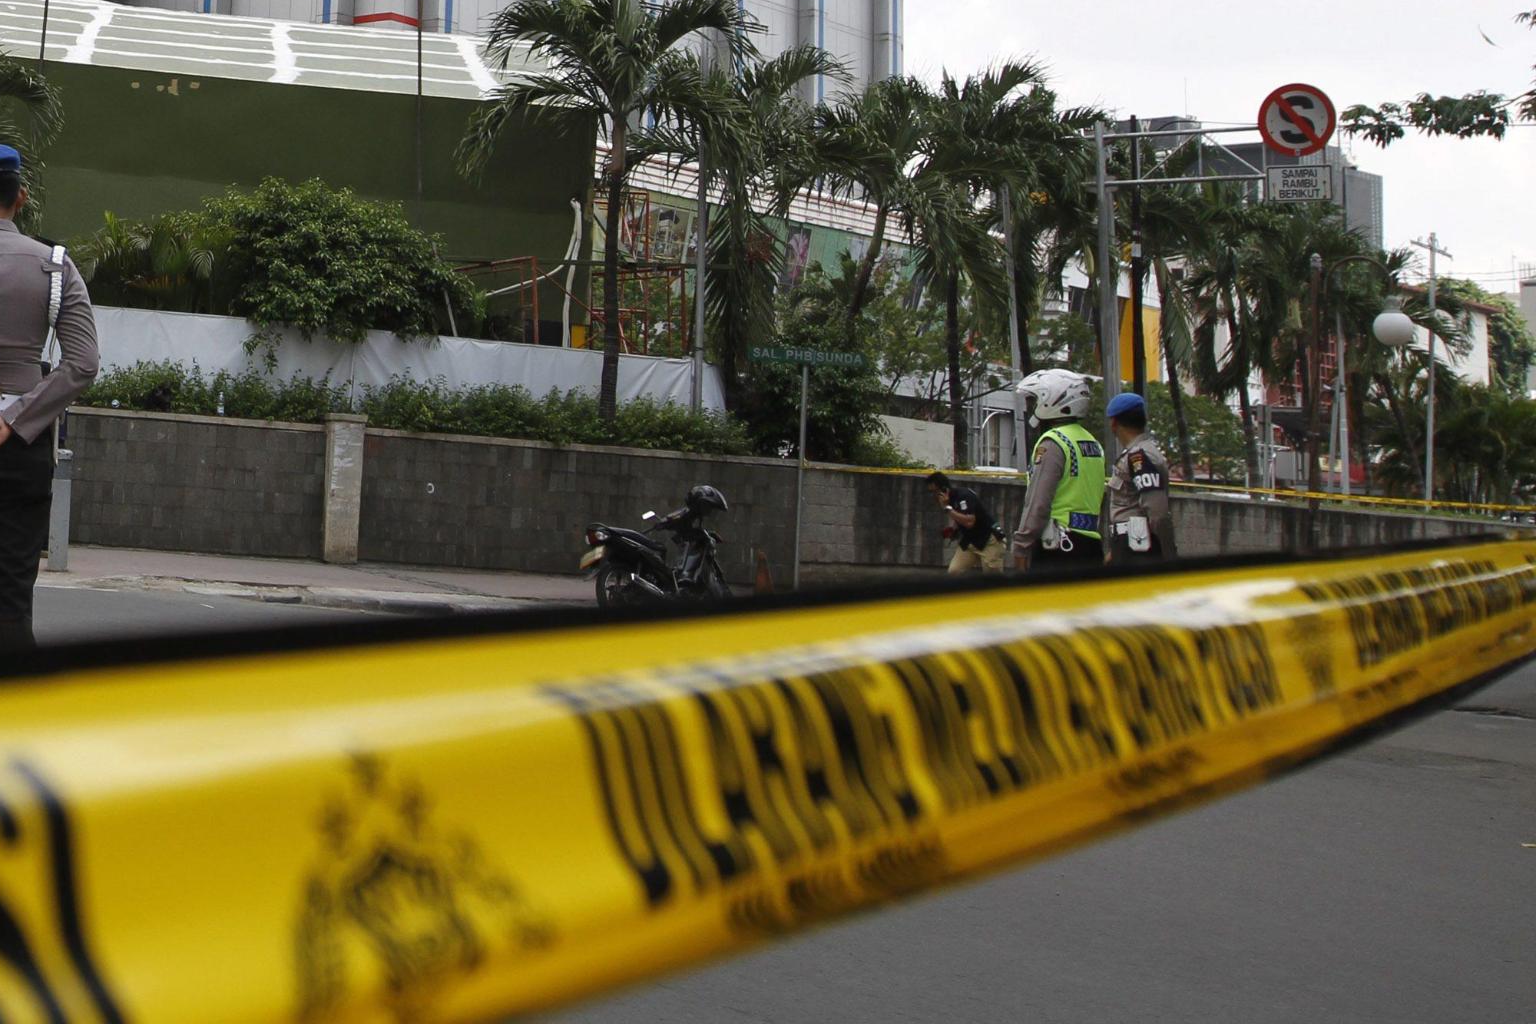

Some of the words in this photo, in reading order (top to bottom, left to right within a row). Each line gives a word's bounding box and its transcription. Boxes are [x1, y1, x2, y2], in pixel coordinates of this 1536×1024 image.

[1281, 169, 1318, 178] SAMPAI
[1282, 179, 1318, 188] RAMBU
[1279, 188, 1321, 199] BERIKUT
[816, 351, 862, 364] SUNDA
